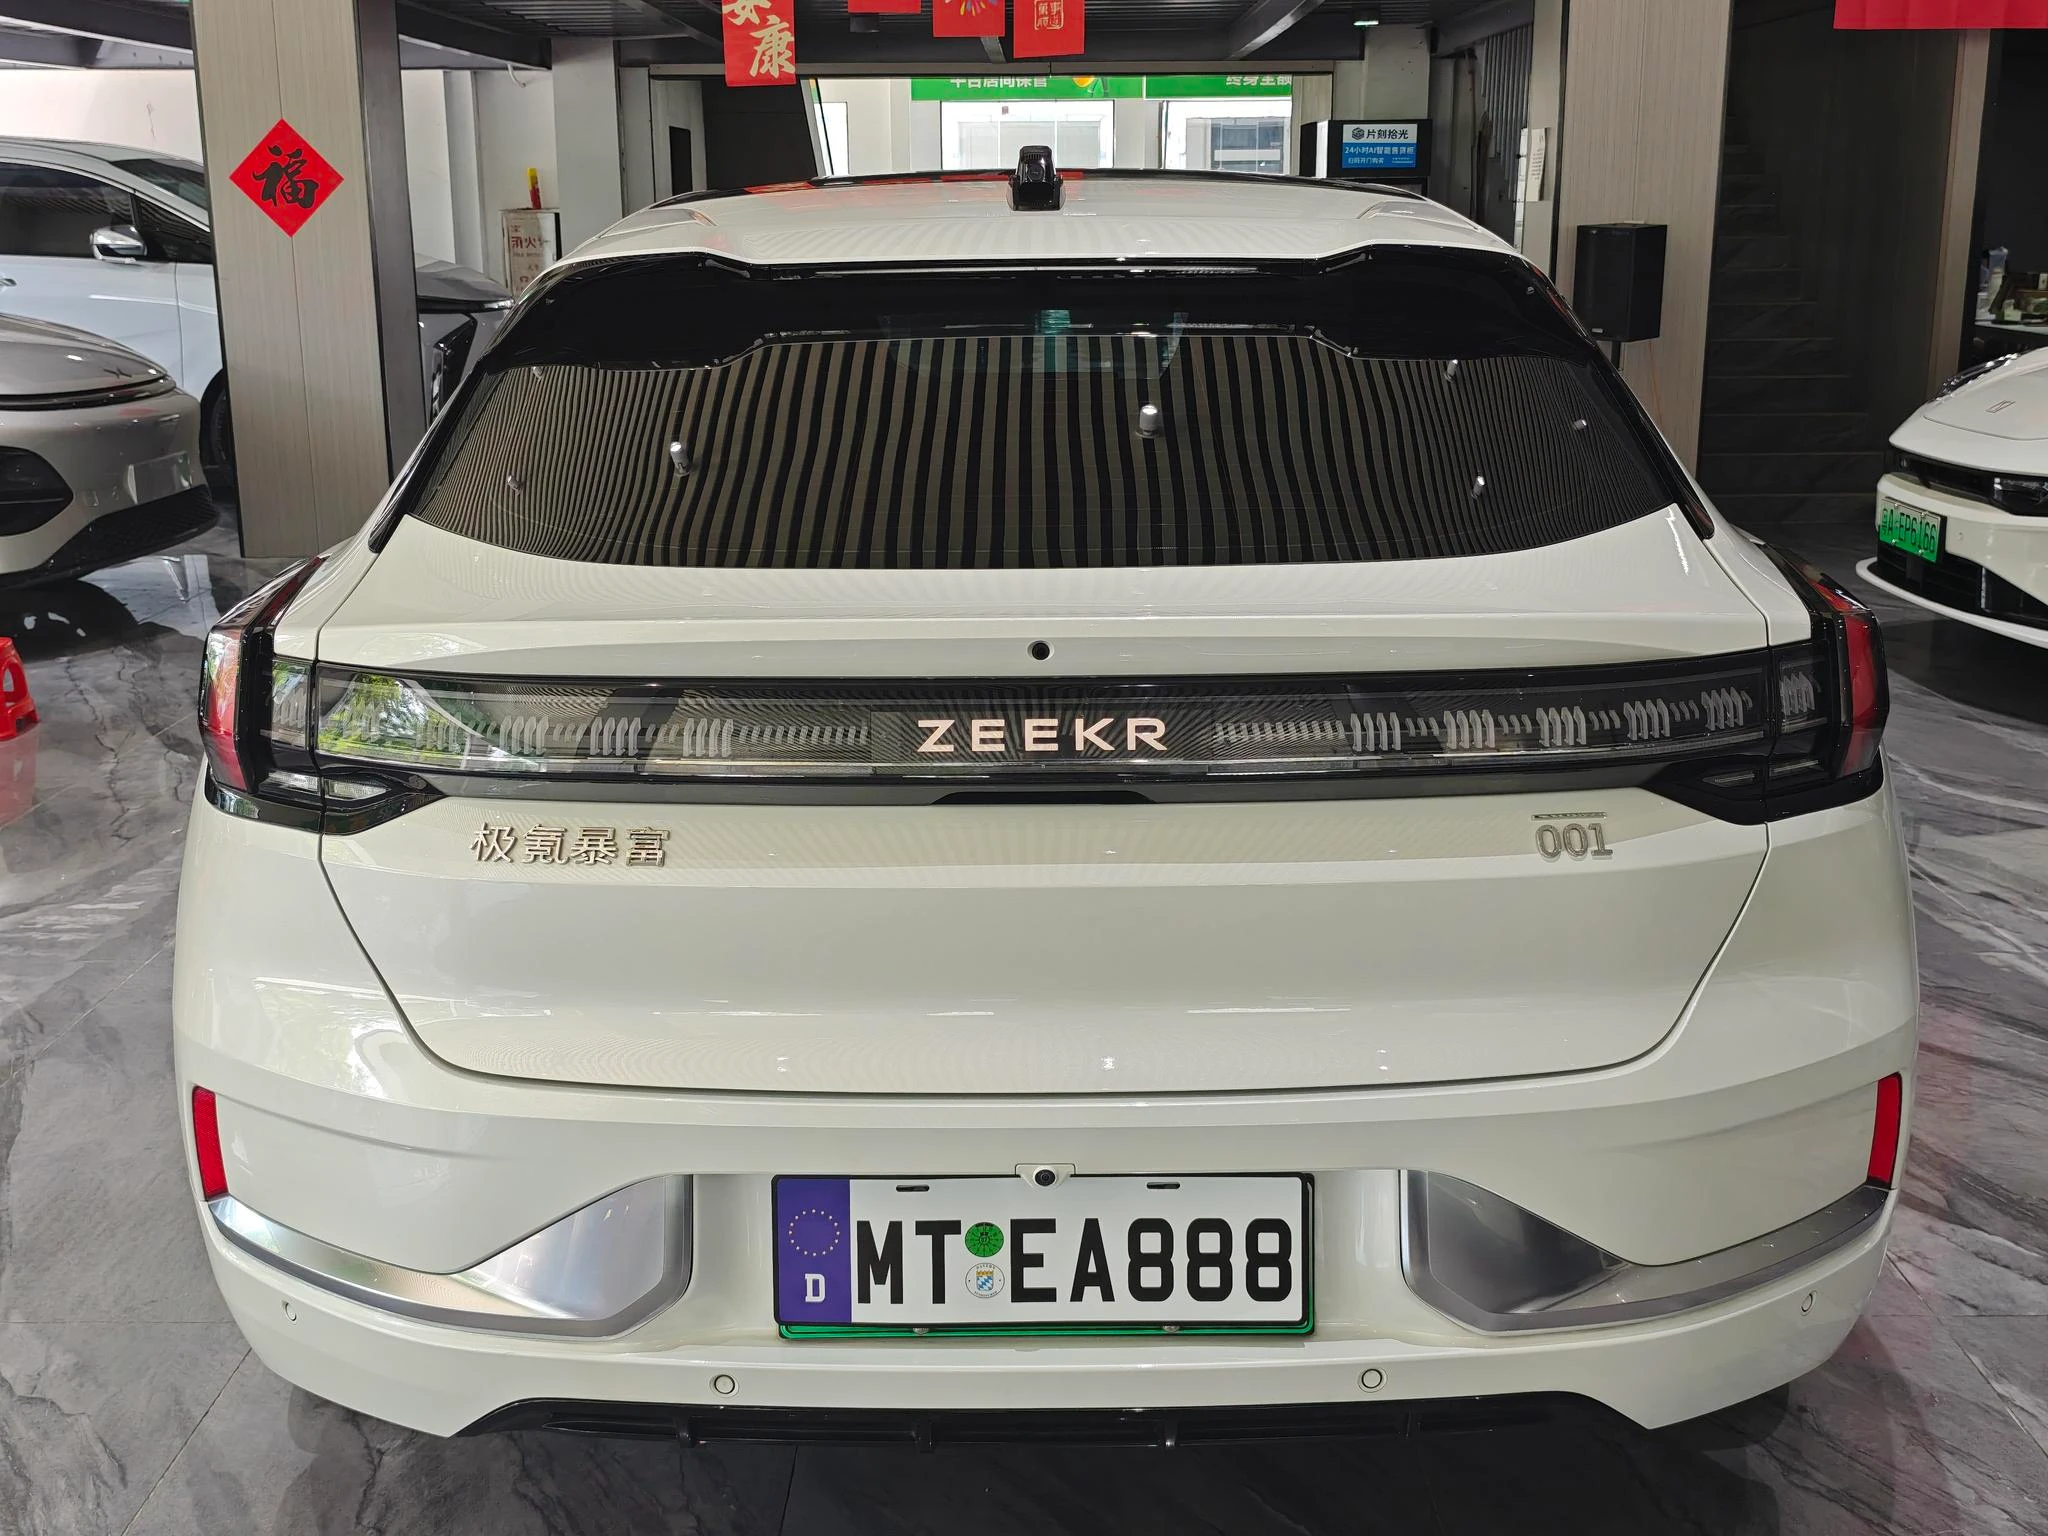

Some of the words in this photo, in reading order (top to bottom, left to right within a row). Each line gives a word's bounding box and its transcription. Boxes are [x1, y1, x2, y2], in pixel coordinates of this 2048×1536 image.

[1366, 128, 1409, 140] 片刻拾光
[252, 144, 320, 209] 福
[511, 235, 546, 249] 消火
[917, 718, 1168, 752] ZEEKR
[470, 822, 672, 867] 极氪暴富
[1535, 823, 1613, 859] 001
[804, 1273, 826, 1303] D
[856, 1219, 962, 1305] MT
[1010, 1217, 1293, 1303] EA888
